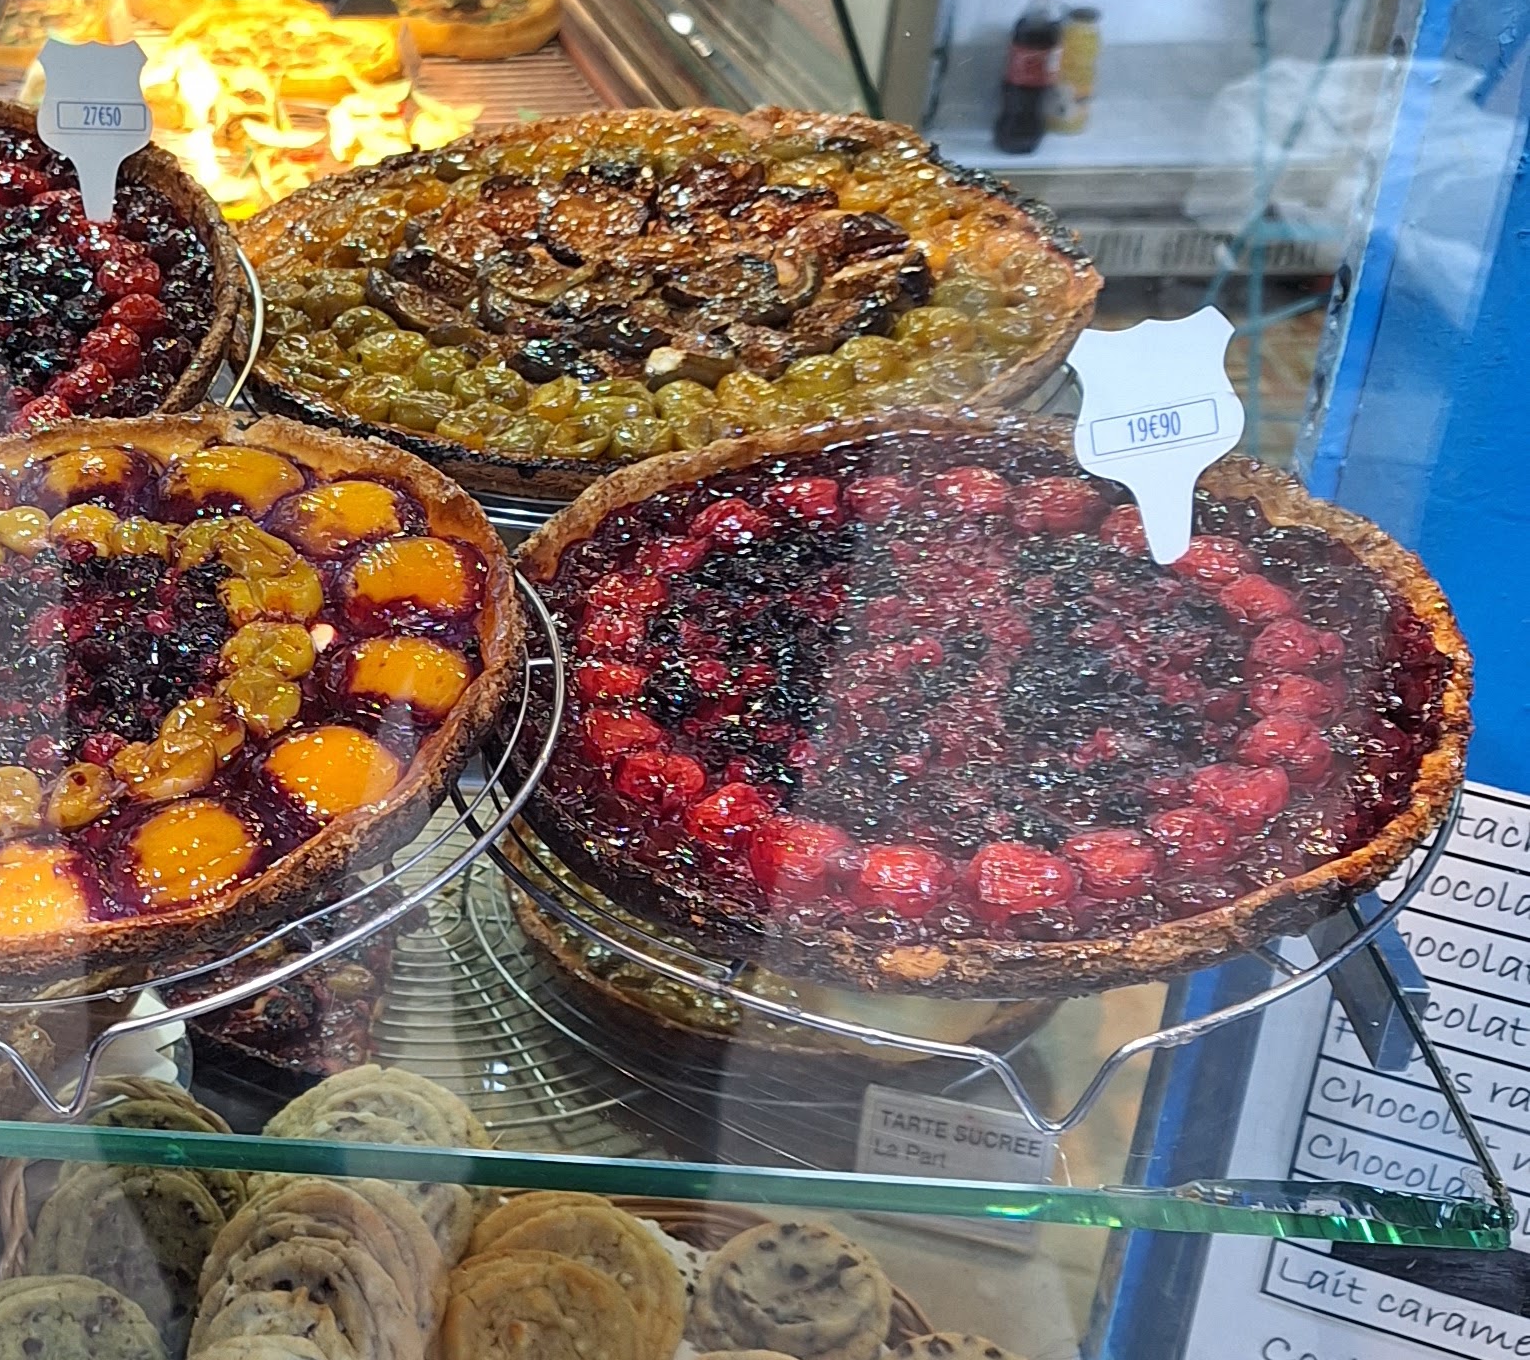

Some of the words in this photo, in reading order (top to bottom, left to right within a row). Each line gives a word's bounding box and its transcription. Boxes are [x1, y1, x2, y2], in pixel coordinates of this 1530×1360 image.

[83, 106, 122, 127] 27€50
[1127, 411, 1182, 443] 19€90
[881, 1110, 948, 1139] TARTE
[874, 1138, 898, 1158] La
[906, 1143, 947, 1168] Part
[1279, 1257, 1367, 1305] Lait
